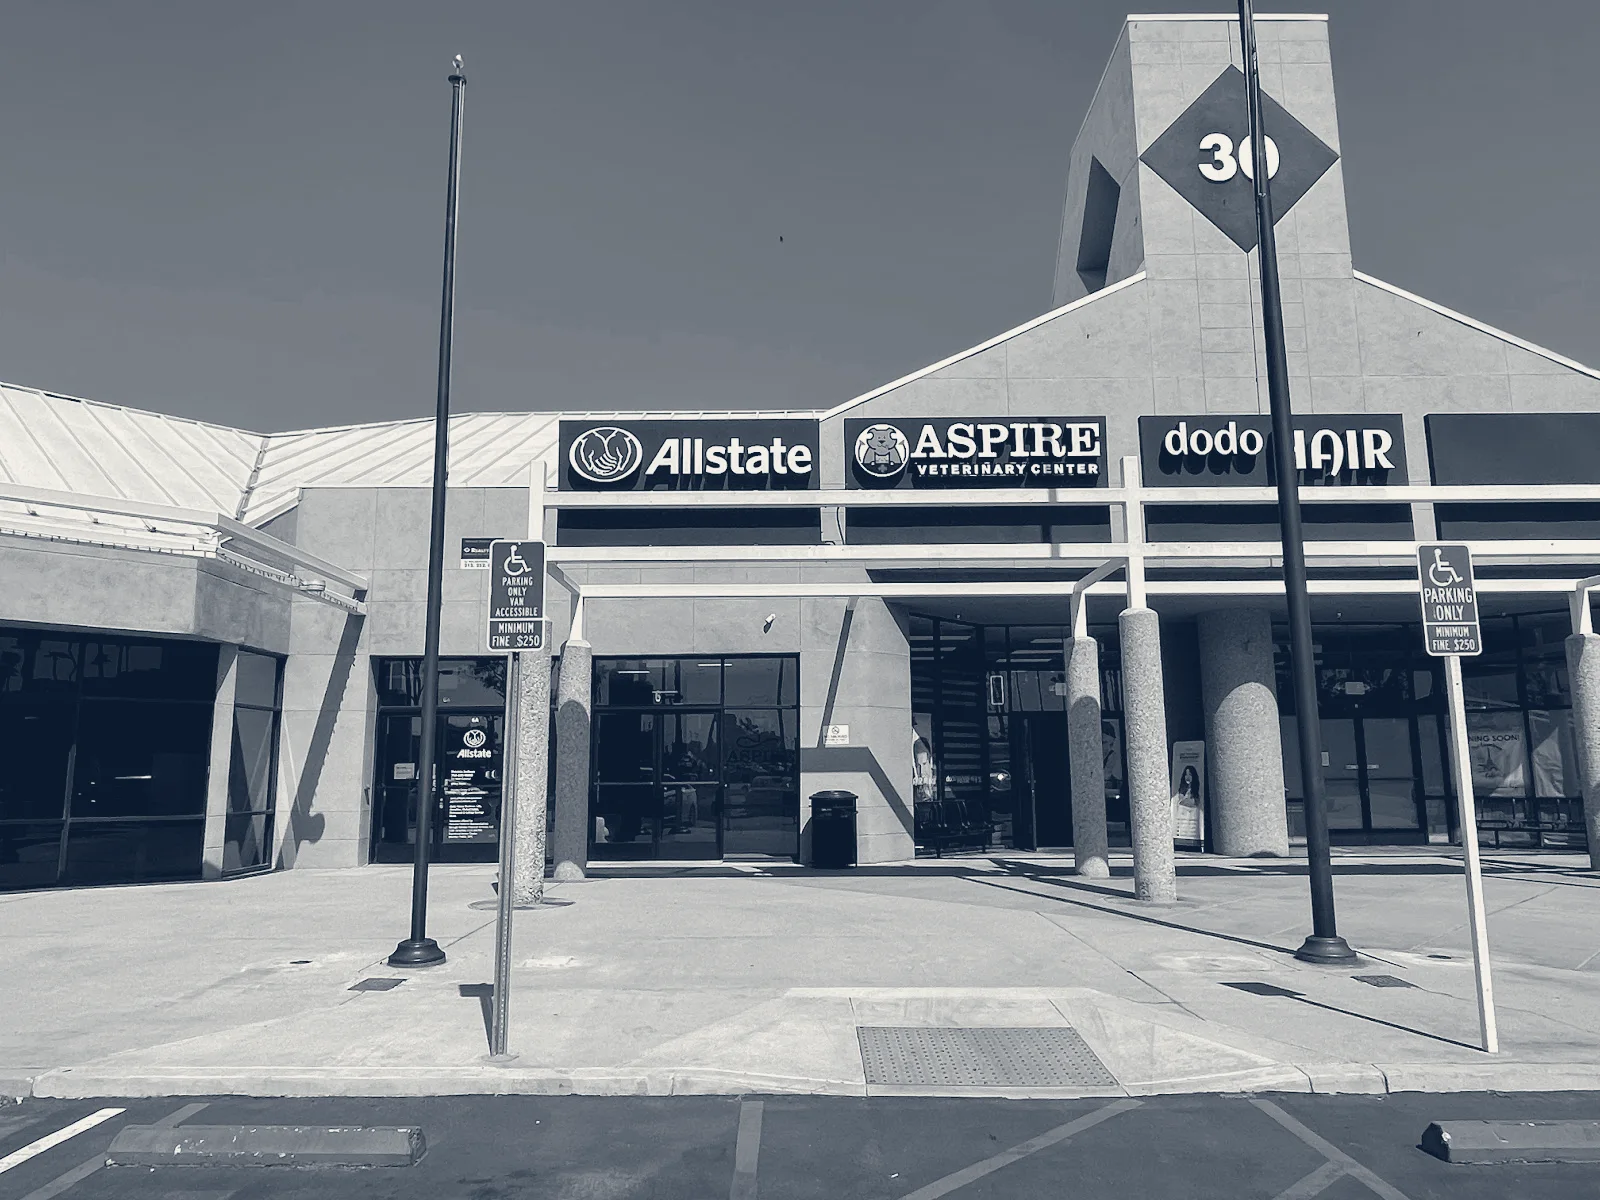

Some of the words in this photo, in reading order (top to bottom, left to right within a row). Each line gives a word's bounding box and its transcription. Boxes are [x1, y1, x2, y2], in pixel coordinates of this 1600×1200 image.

[1198, 132, 1280, 182] 30
[910, 422, 1101, 458] ASPIRE
[1164, 421, 1264, 456] dodo
[644, 437, 812, 475] Allstate
[917, 463, 1026, 475] VETERINARY
[1031, 463, 1099, 475] CENTER
[502, 577, 533, 586] PARKING
[507, 587, 527, 597] ONLY
[1424, 587, 1473, 603] PARKING
[510, 597, 524, 606] VAN
[495, 607, 538, 617] ACCESSIBLE
[1436, 605, 1464, 621] ONLY
[498, 622, 534, 634] MINIMUM
[1435, 626, 1470, 638] MINIMUM
[492, 636, 510, 647] FINE
[516, 635, 540, 647] $250
[1432, 639, 1450, 651] FINE
[1454, 639, 1476, 651] $250
[457, 749, 492, 759] Allstate
